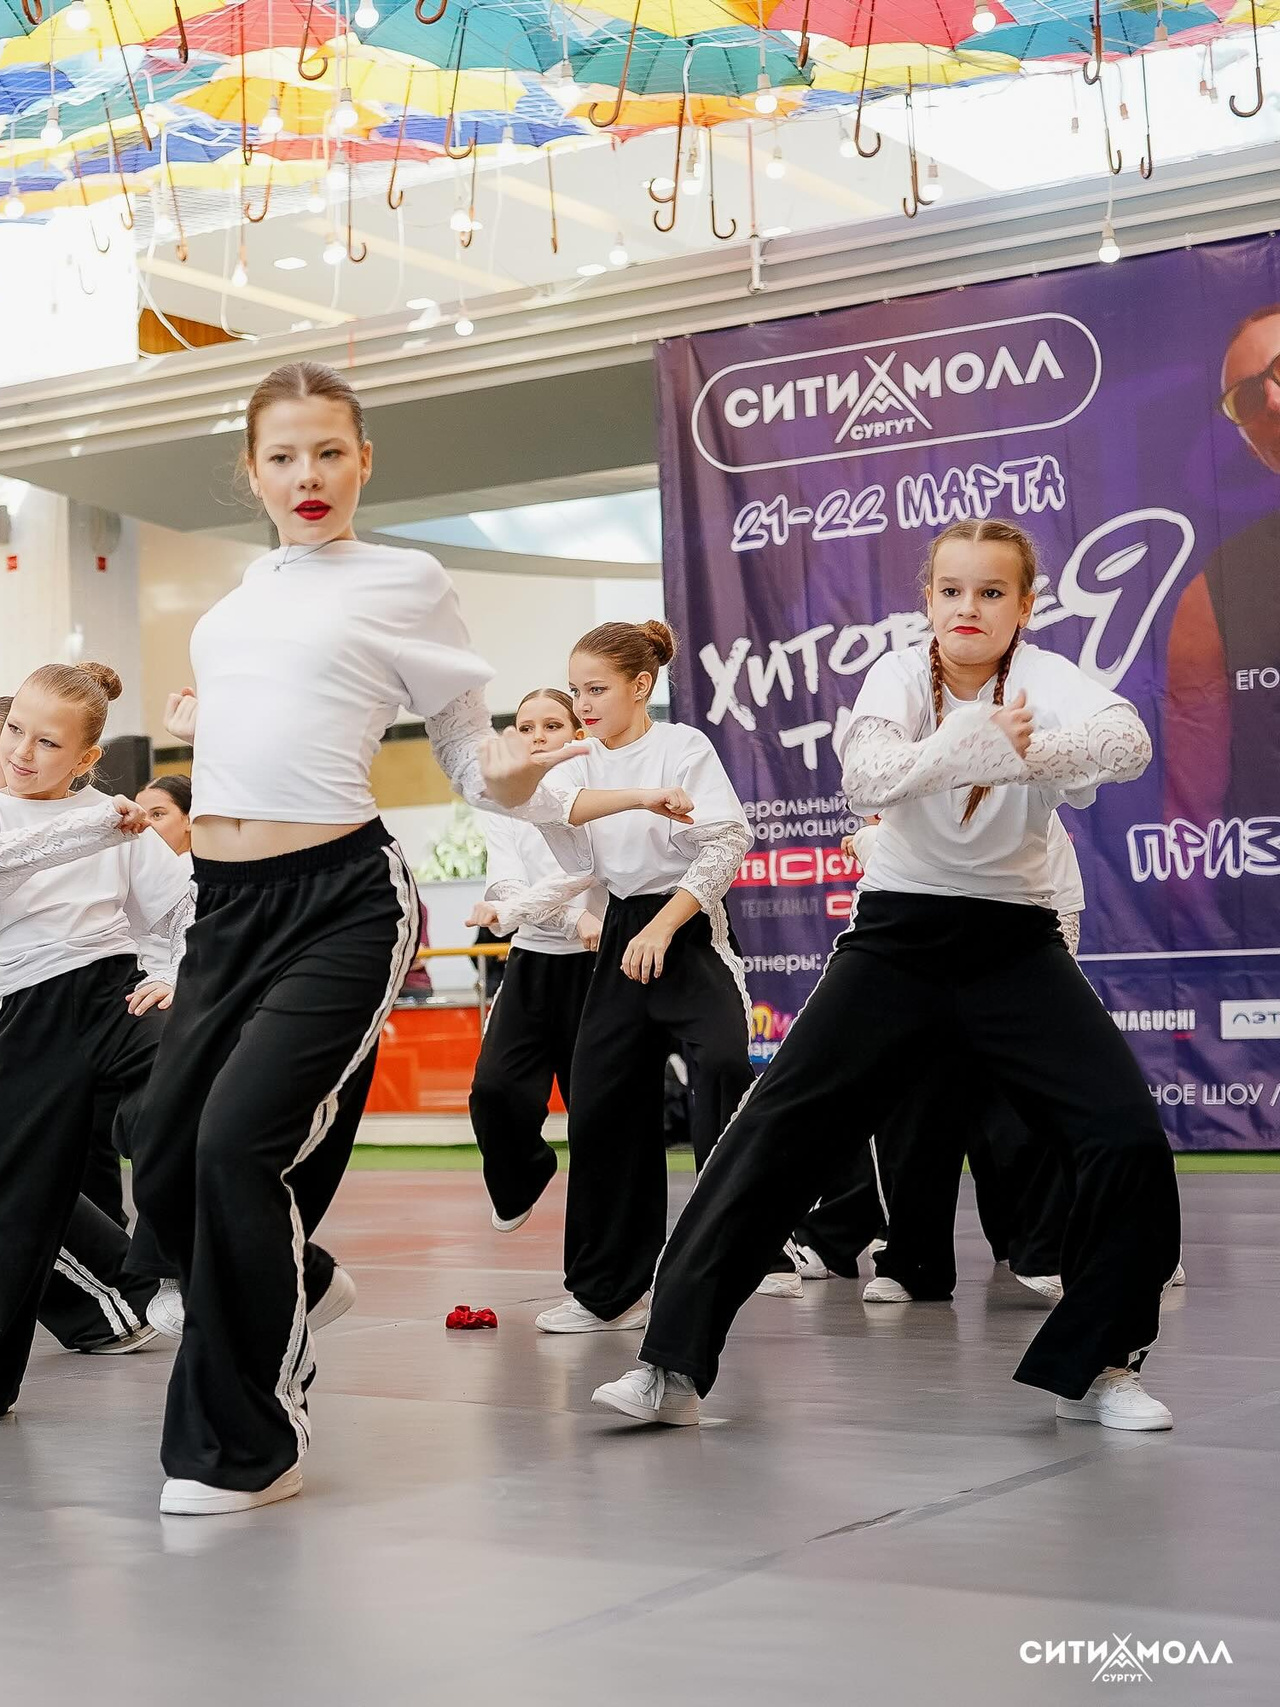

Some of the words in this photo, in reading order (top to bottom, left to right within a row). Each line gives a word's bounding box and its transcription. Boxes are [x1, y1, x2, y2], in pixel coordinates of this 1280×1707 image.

[724, 370, 860, 428] СИТИ
[903, 339, 1065, 399] МОЛЛ
[849, 416, 916, 440] СУРГУТ
[731, 484, 889, 552] 21-22
[896, 454, 1066, 530] МАРТА
[1236, 667, 1280, 691] ЕГО
[743, 790, 849, 821] еральный
[750, 815, 864, 843] ормацио
[1126, 816, 1280, 883] ПРИЗ
[1110, 1009, 1196, 1032] MAGUCHI
[1232, 1011, 1280, 1025] ЛЭТ
[1147, 1083, 1196, 1106] НОЕ
[1202, 1082, 1264, 1106] ШОУ
